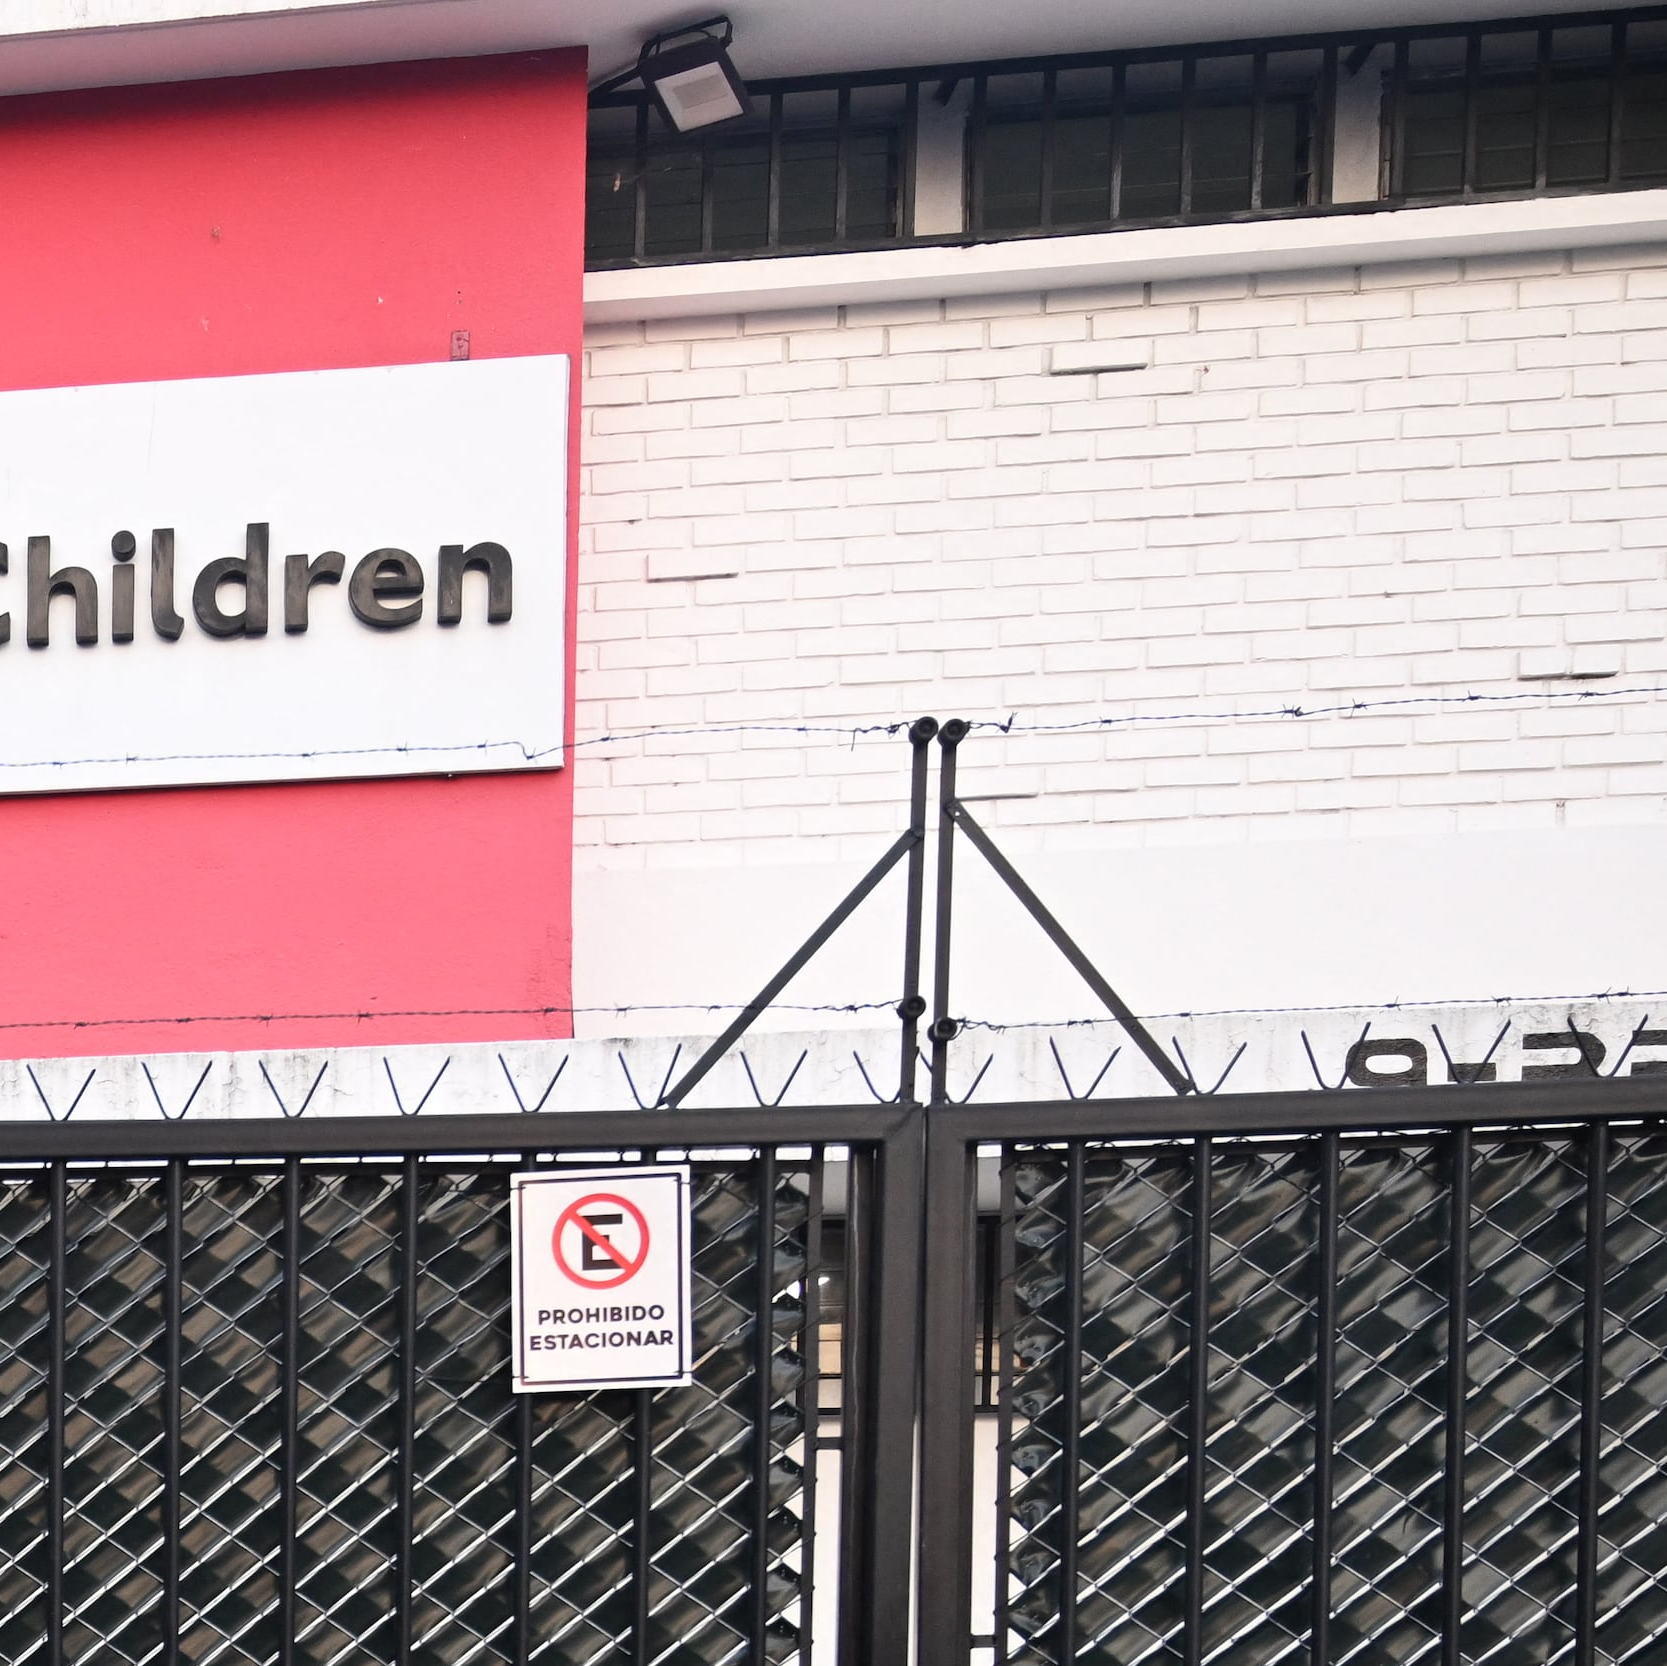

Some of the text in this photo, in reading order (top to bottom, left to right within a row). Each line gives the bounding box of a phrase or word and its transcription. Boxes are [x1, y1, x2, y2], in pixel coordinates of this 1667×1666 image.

[582, 1214, 623, 1271] E
[538, 1305, 664, 1325] PROHIBIDO
[530, 1330, 673, 1351] ESTACIONAR
